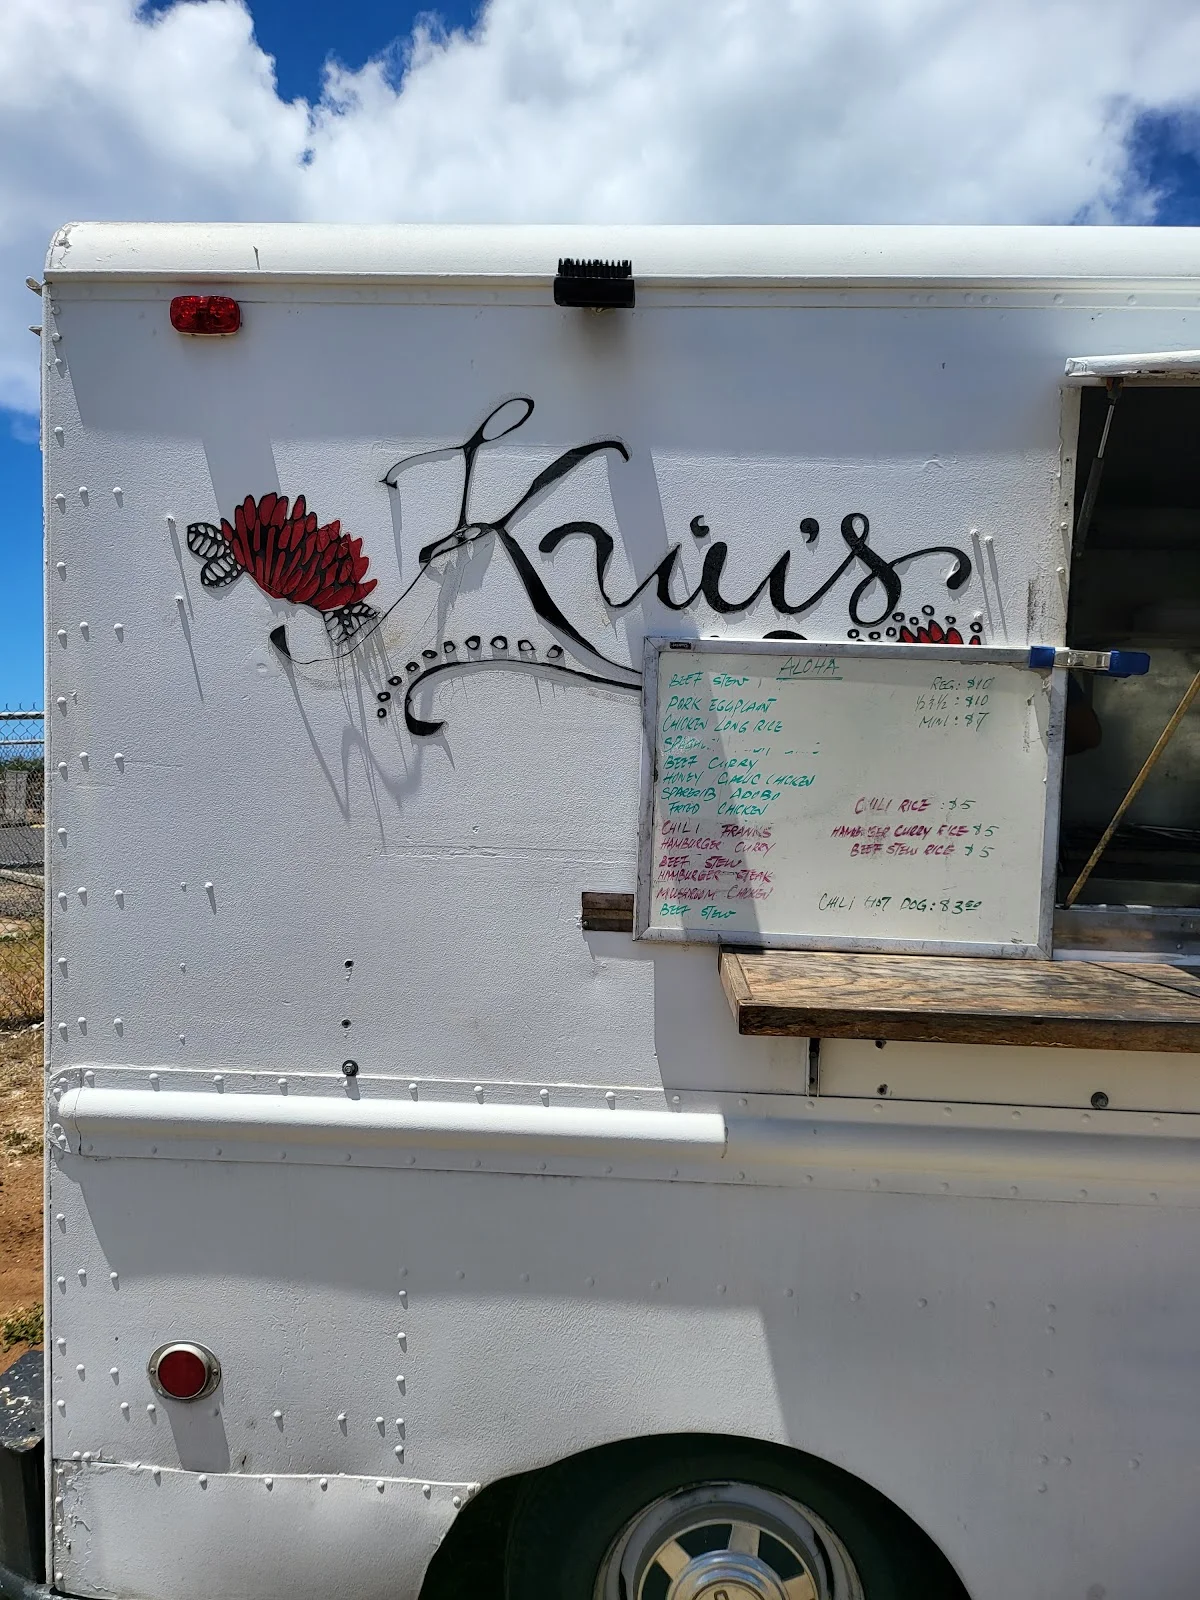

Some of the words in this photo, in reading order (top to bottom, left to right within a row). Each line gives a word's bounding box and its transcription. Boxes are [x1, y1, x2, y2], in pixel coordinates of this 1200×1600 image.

[779, 656, 840, 676] ALOHA
[669, 672, 704, 688] BEEF
[713, 673, 750, 687] STEW
[966, 675, 994, 692] $10
[666, 696, 702, 714] PORK
[708, 698, 777, 718] EGGPLANT
[965, 694, 989, 708] $10
[663, 715, 709, 735] CHICKEN
[714, 716, 747, 733] LONG
[753, 719, 783, 733] RICE
[965, 712, 990, 732] $7
[662, 755, 698, 770] BEEF
[708, 756, 759, 773] CURRY
[662, 771, 705, 786] HONEY
[717, 772, 761, 786] GARLIC
[765, 774, 816, 788] CHICKEN
[730, 789, 782, 801] ADOBO
[717, 802, 769, 816] CHICKEN
[898, 798, 933, 812] RICE
[660, 820, 701, 836] CHILI
[894, 825, 933, 840] CURRY
[973, 824, 999, 838] $5
[660, 835, 721, 851] HAMBURGER
[734, 841, 777, 858] CURRY
[850, 843, 884, 858] BEEF
[887, 843, 918, 856] STEW
[923, 843, 956, 856] RICE
[964, 843, 995, 858] $5
[658, 855, 690, 868] BEEF
[704, 855, 743, 870] STEW
[657, 868, 721, 882] HAMBURGER
[736, 869, 775, 883] STEAK
[726, 884, 774, 901] CHICKEN
[818, 892, 856, 911] CHILI
[864, 896, 893, 911] HOT
[659, 903, 692, 918] BEEF
[701, 905, 736, 919] STEW
